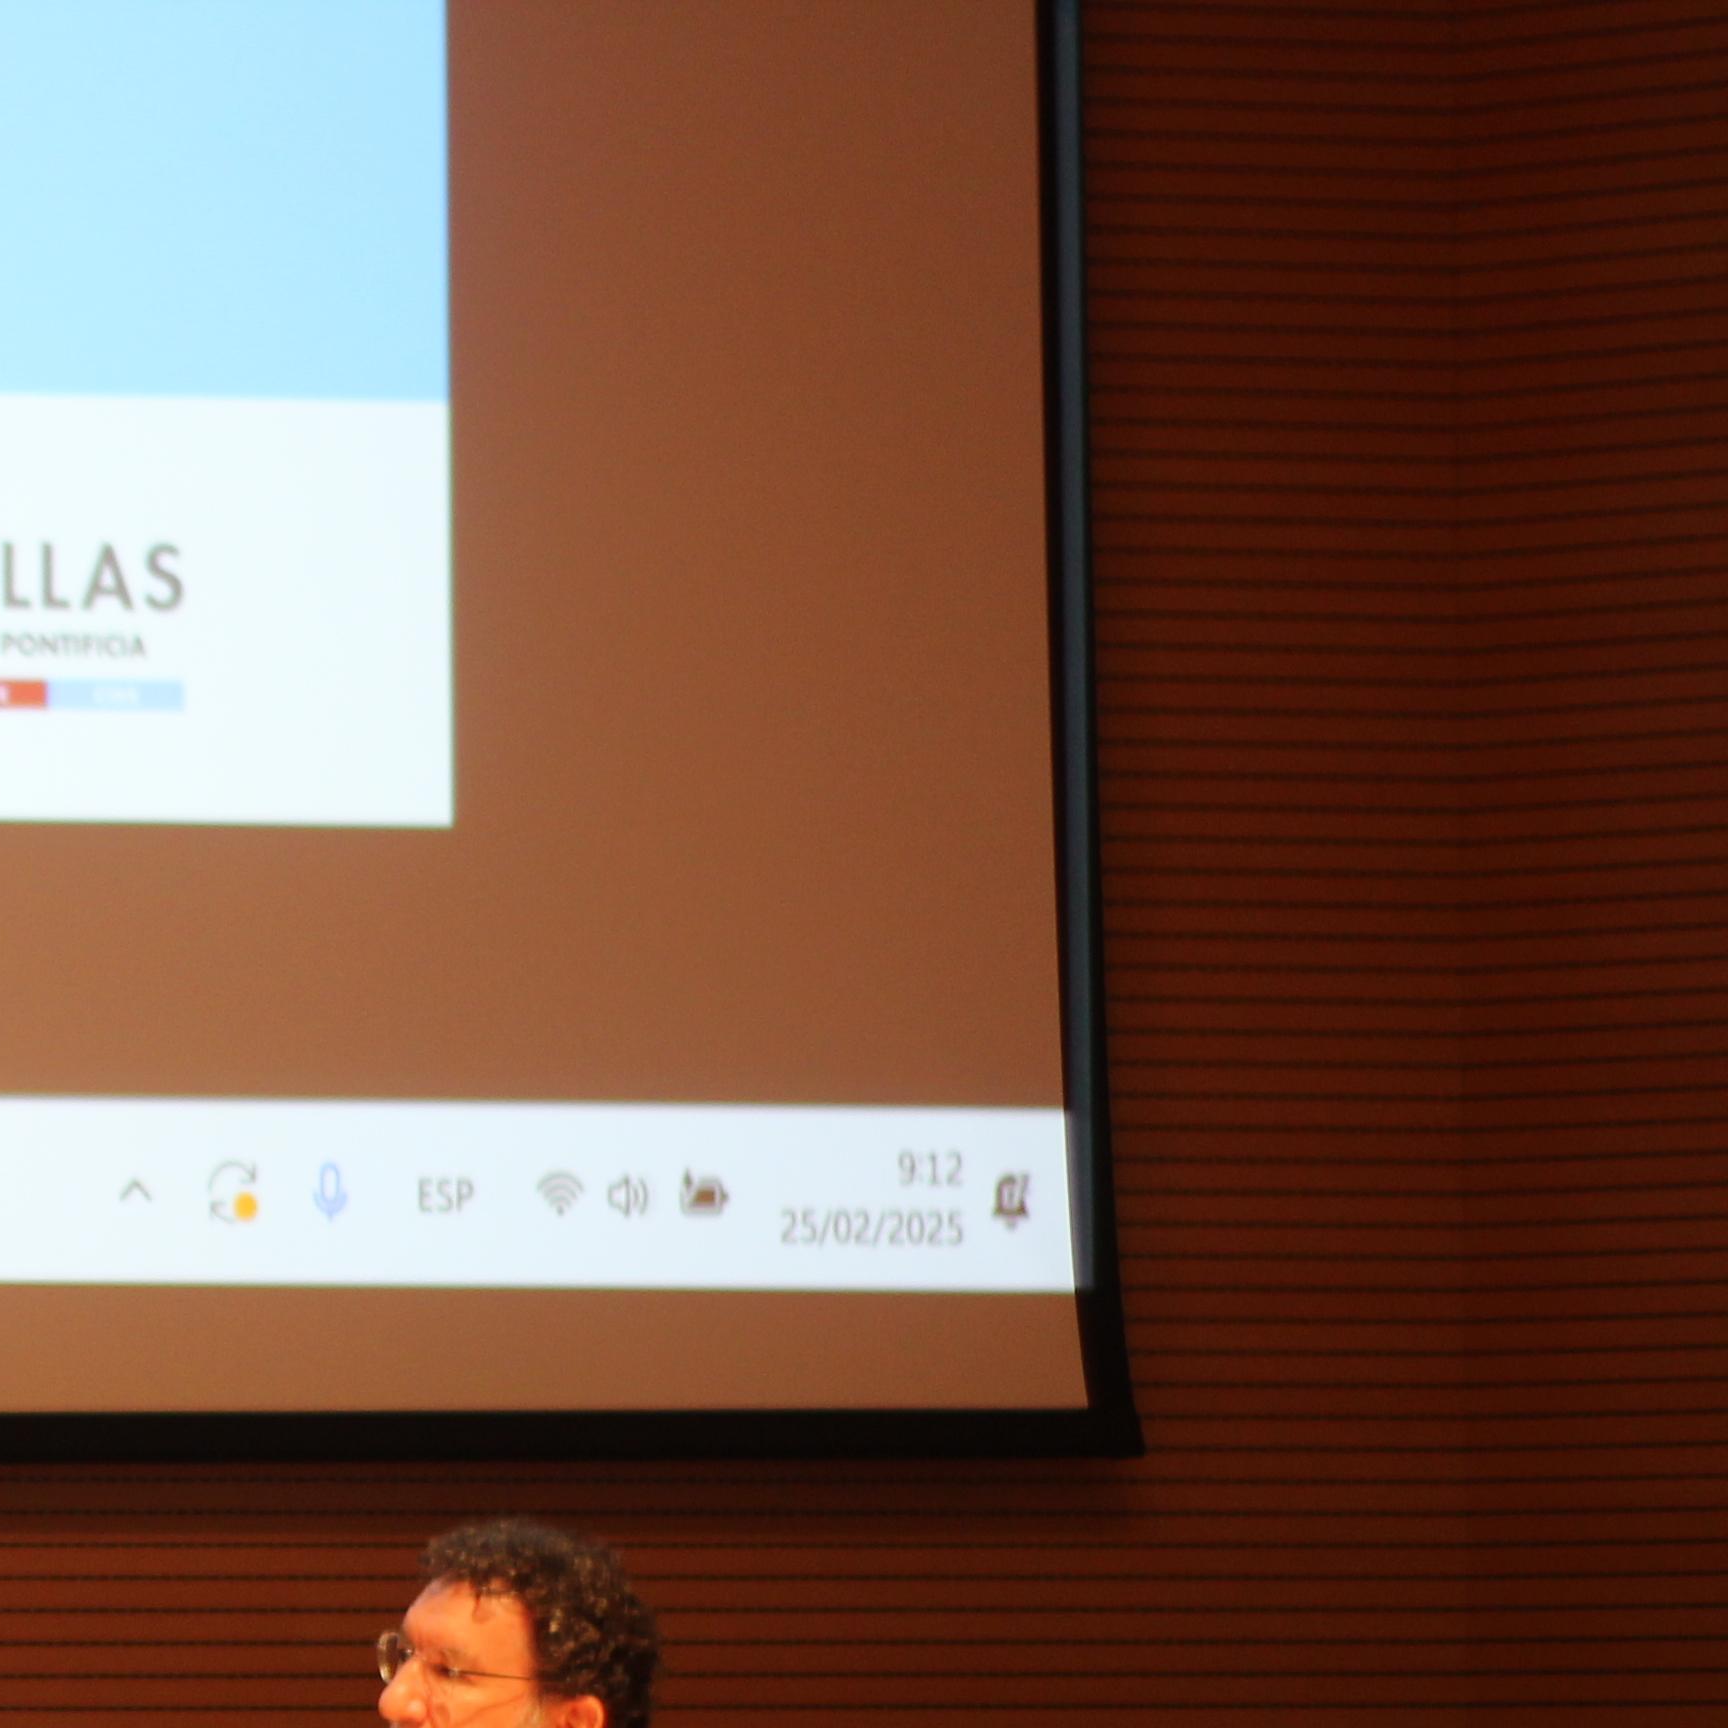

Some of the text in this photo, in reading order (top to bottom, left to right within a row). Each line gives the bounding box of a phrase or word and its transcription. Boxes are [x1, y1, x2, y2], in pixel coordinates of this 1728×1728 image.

[0, 631, 147, 658] PONTIFICIA
[897, 1150, 964, 1187] 9:12
[416, 1176, 476, 1215] ESP
[780, 1208, 965, 1248] 25/02/2025
